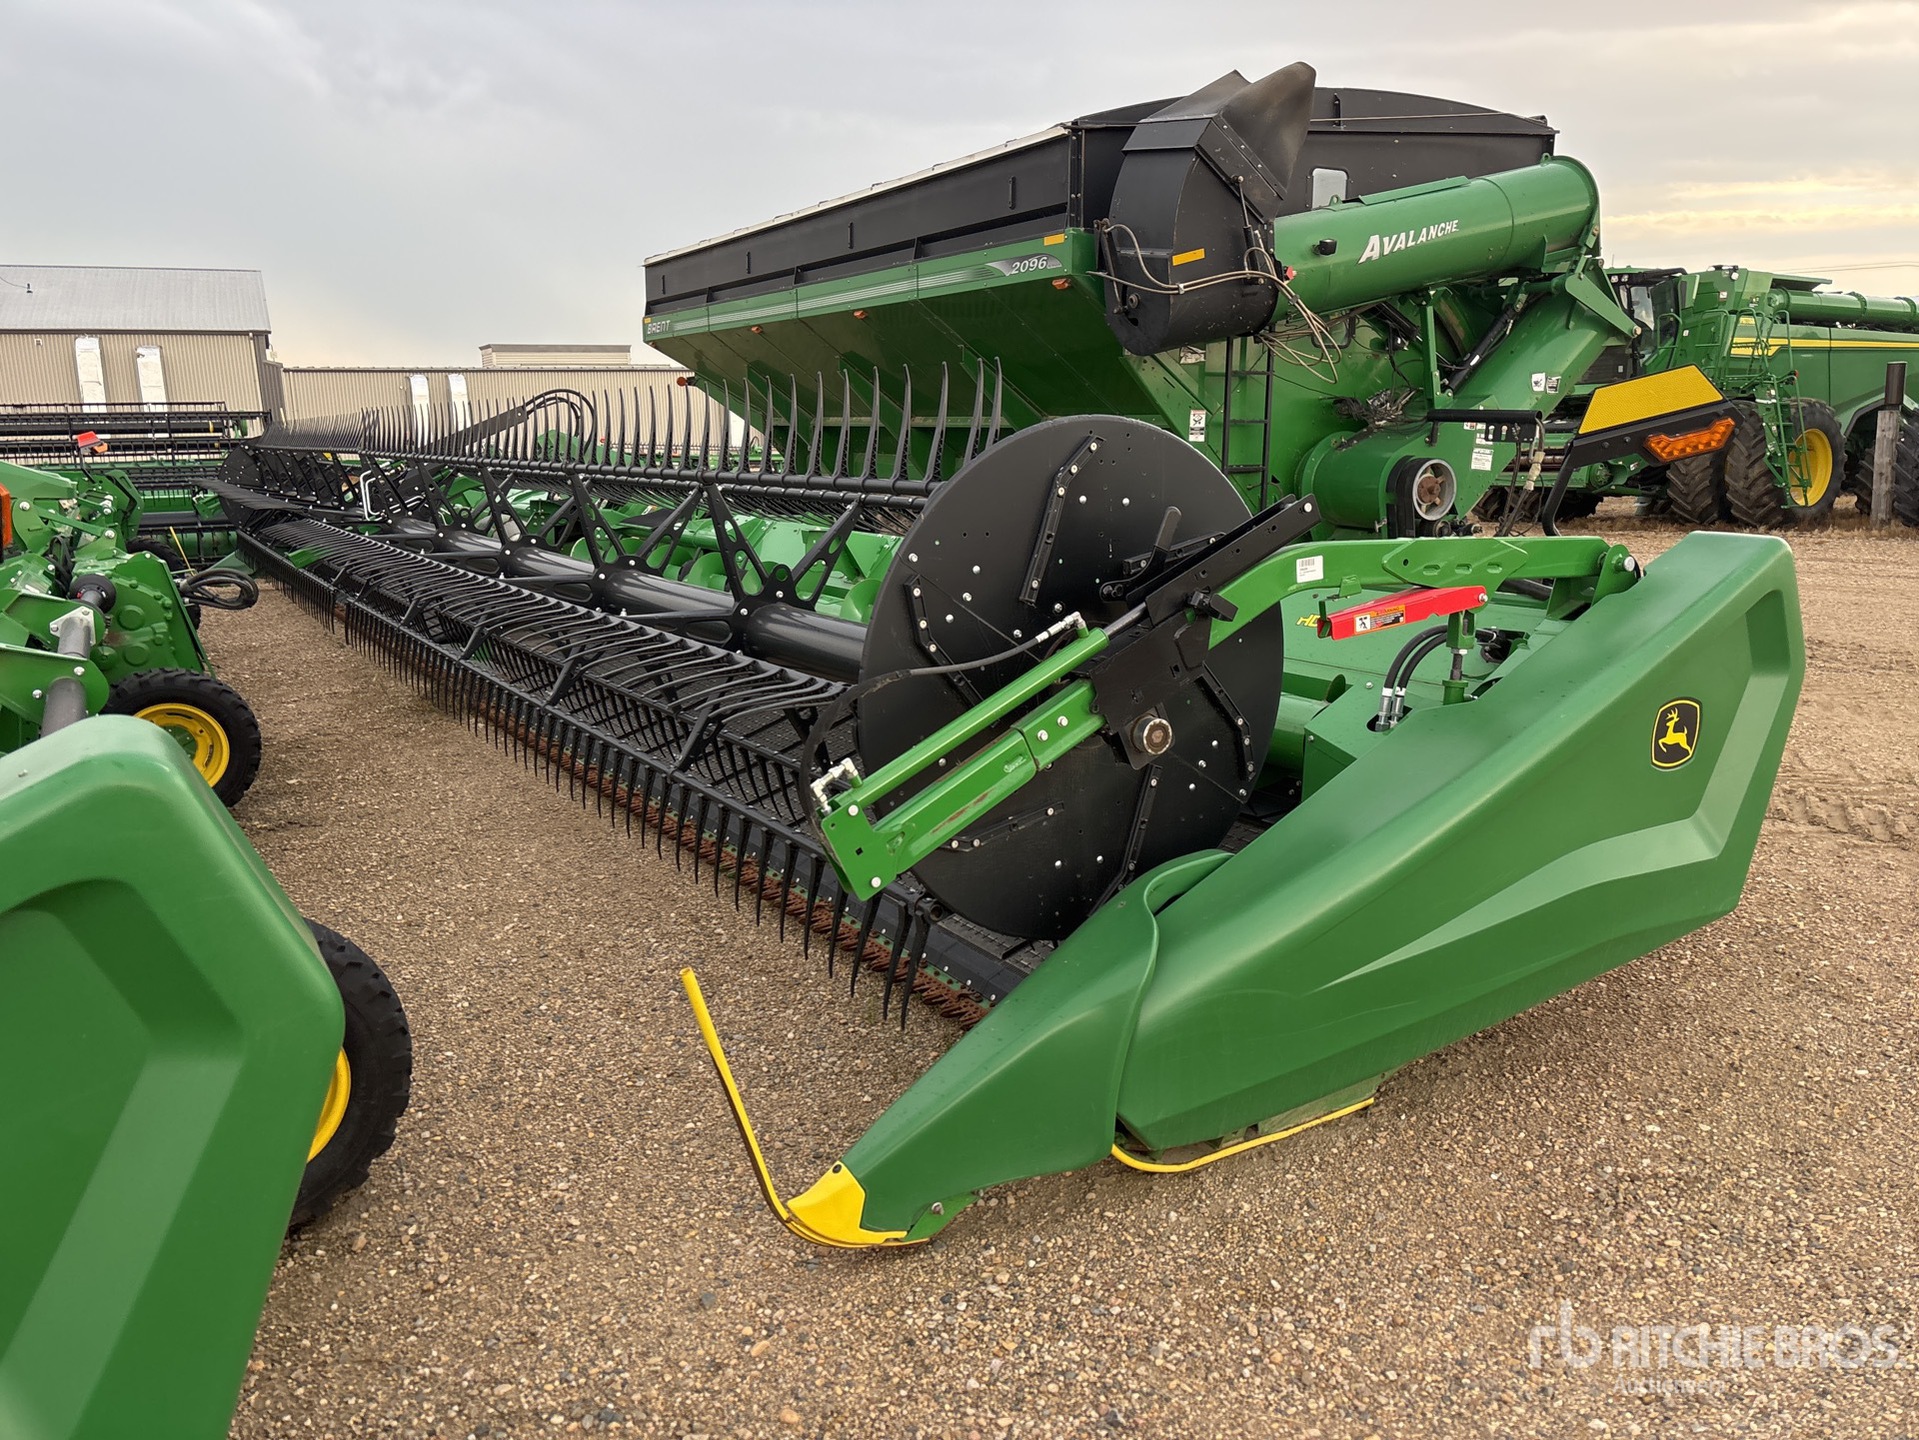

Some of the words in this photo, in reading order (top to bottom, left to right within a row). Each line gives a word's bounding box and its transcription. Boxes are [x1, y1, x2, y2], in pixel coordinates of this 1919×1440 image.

[1357, 219, 1460, 265] AVALANCHE
[1011, 256, 1047, 275] 2096
[647, 319, 671, 335] BRENT
